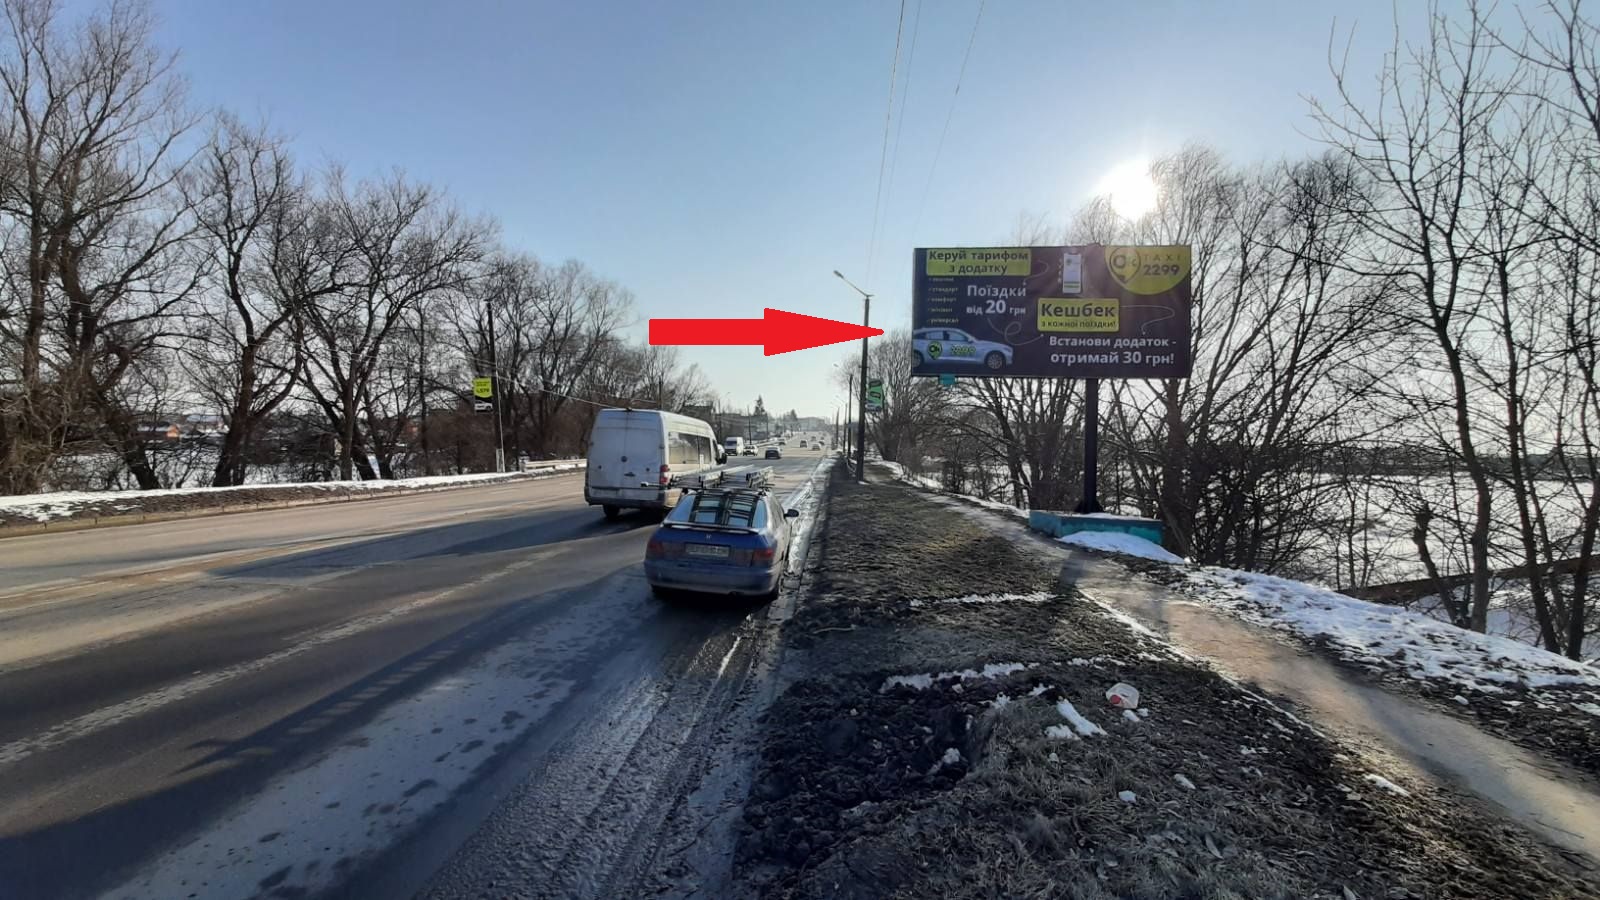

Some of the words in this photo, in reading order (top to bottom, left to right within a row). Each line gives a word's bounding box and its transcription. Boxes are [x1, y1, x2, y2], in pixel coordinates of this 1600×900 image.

[929, 249, 967, 262] Керуй
[971, 250, 1028, 262] тарифом
[949, 265, 955, 273] з
[958, 265, 1008, 274] додатку
[1143, 264, 1180, 276] 2299
[967, 285, 1026, 298] Поїздки
[966, 305, 983, 315] від
[985, 300, 1006, 314] 20
[1009, 307, 1026, 316] грн
[1041, 303, 1115, 317] Кешбек
[1050, 336, 1111, 346] Встанови
[1114, 337, 1169, 348] додаток
[1051, 352, 1119, 366] отримай
[1122, 352, 1142, 364] 30
[1146, 353, 1174, 366] грн!
